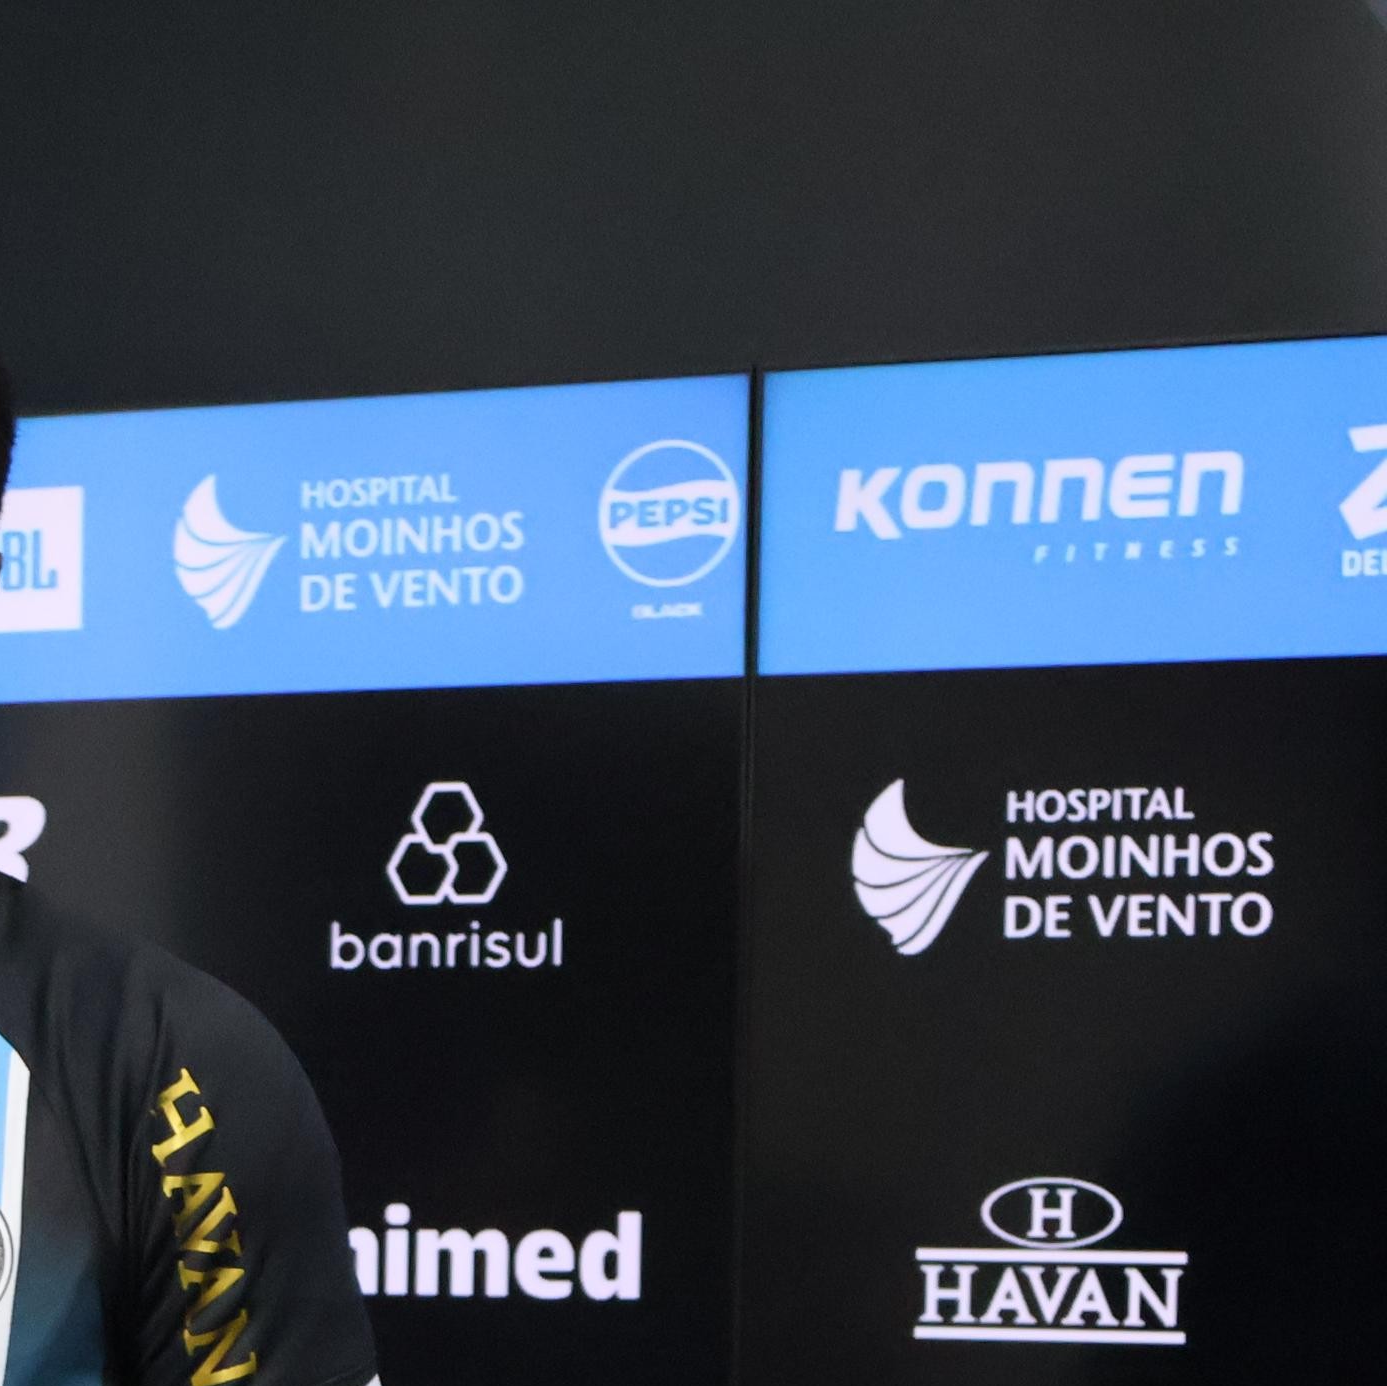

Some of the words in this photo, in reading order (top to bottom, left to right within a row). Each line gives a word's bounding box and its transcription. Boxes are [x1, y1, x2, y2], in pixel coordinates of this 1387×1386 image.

[301, 473, 457, 509] HOSPITAL
[610, 497, 729, 529] PEPSI
[835, 451, 1244, 540] KONNEN
[301, 511, 524, 559] MOINHOS
[1034, 537, 1239, 563] FITNESS
[1, 529, 58, 591] BL
[300, 573, 356, 612] DE
[370, 564, 525, 609] VENTO
[1006, 786, 1195, 823] HOSPITAL
[1005, 831, 1274, 880] MOINHOS
[1004, 895, 1072, 938] DE
[1087, 892, 1274, 938] VENTO
[330, 918, 564, 970] banrisul
[1027, 1187, 1077, 1239] H
[348, 1202, 643, 1301] nimed
[917, 1263, 1186, 1329] HAVAN
